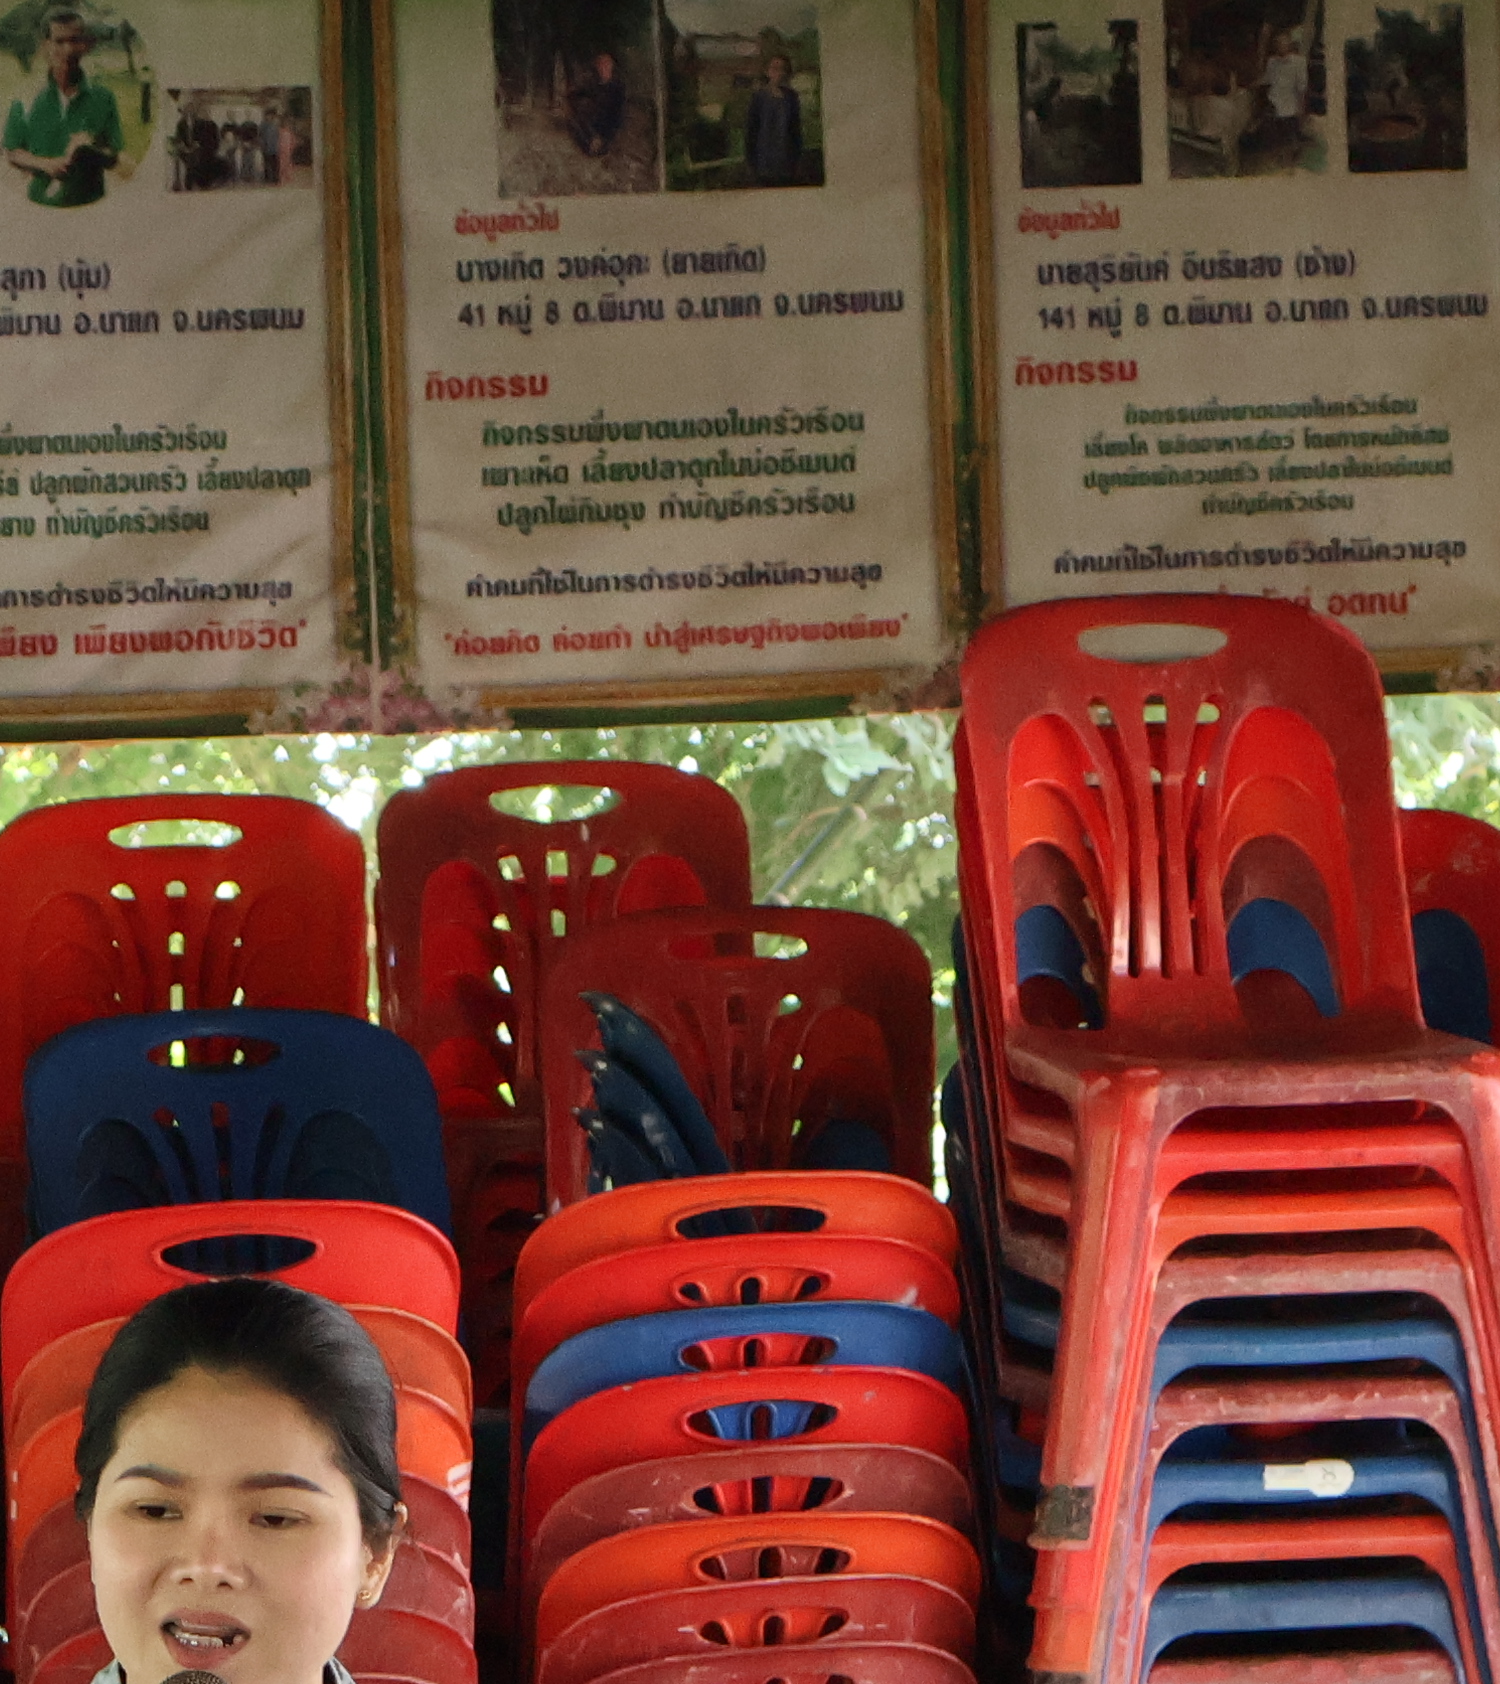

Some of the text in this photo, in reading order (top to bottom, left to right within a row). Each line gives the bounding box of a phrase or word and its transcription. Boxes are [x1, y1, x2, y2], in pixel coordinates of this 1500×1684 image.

[75, 309, 160, 337] อ.นาแก
[174, 306, 305, 333] จ.นครพนม
[458, 300, 484, 328] 41
[498, 293, 532, 335] หมู่
[573, 291, 665, 323] ต.พิมาน
[677, 293, 761, 320] อ.นาแก
[775, 288, 904, 317] จ.นครพนม
[1038, 304, 1077, 331] 141
[1088, 298, 1123, 338] หมู่
[1163, 295, 1252, 326] ต.พิมาน
[1265, 300, 1350, 325] อ.นาแก
[1362, 292, 1489, 320] จ.นครพนม
[425, 369, 549, 401] กิจกรรม
[1014, 356, 1139, 387] กิจกรรม
